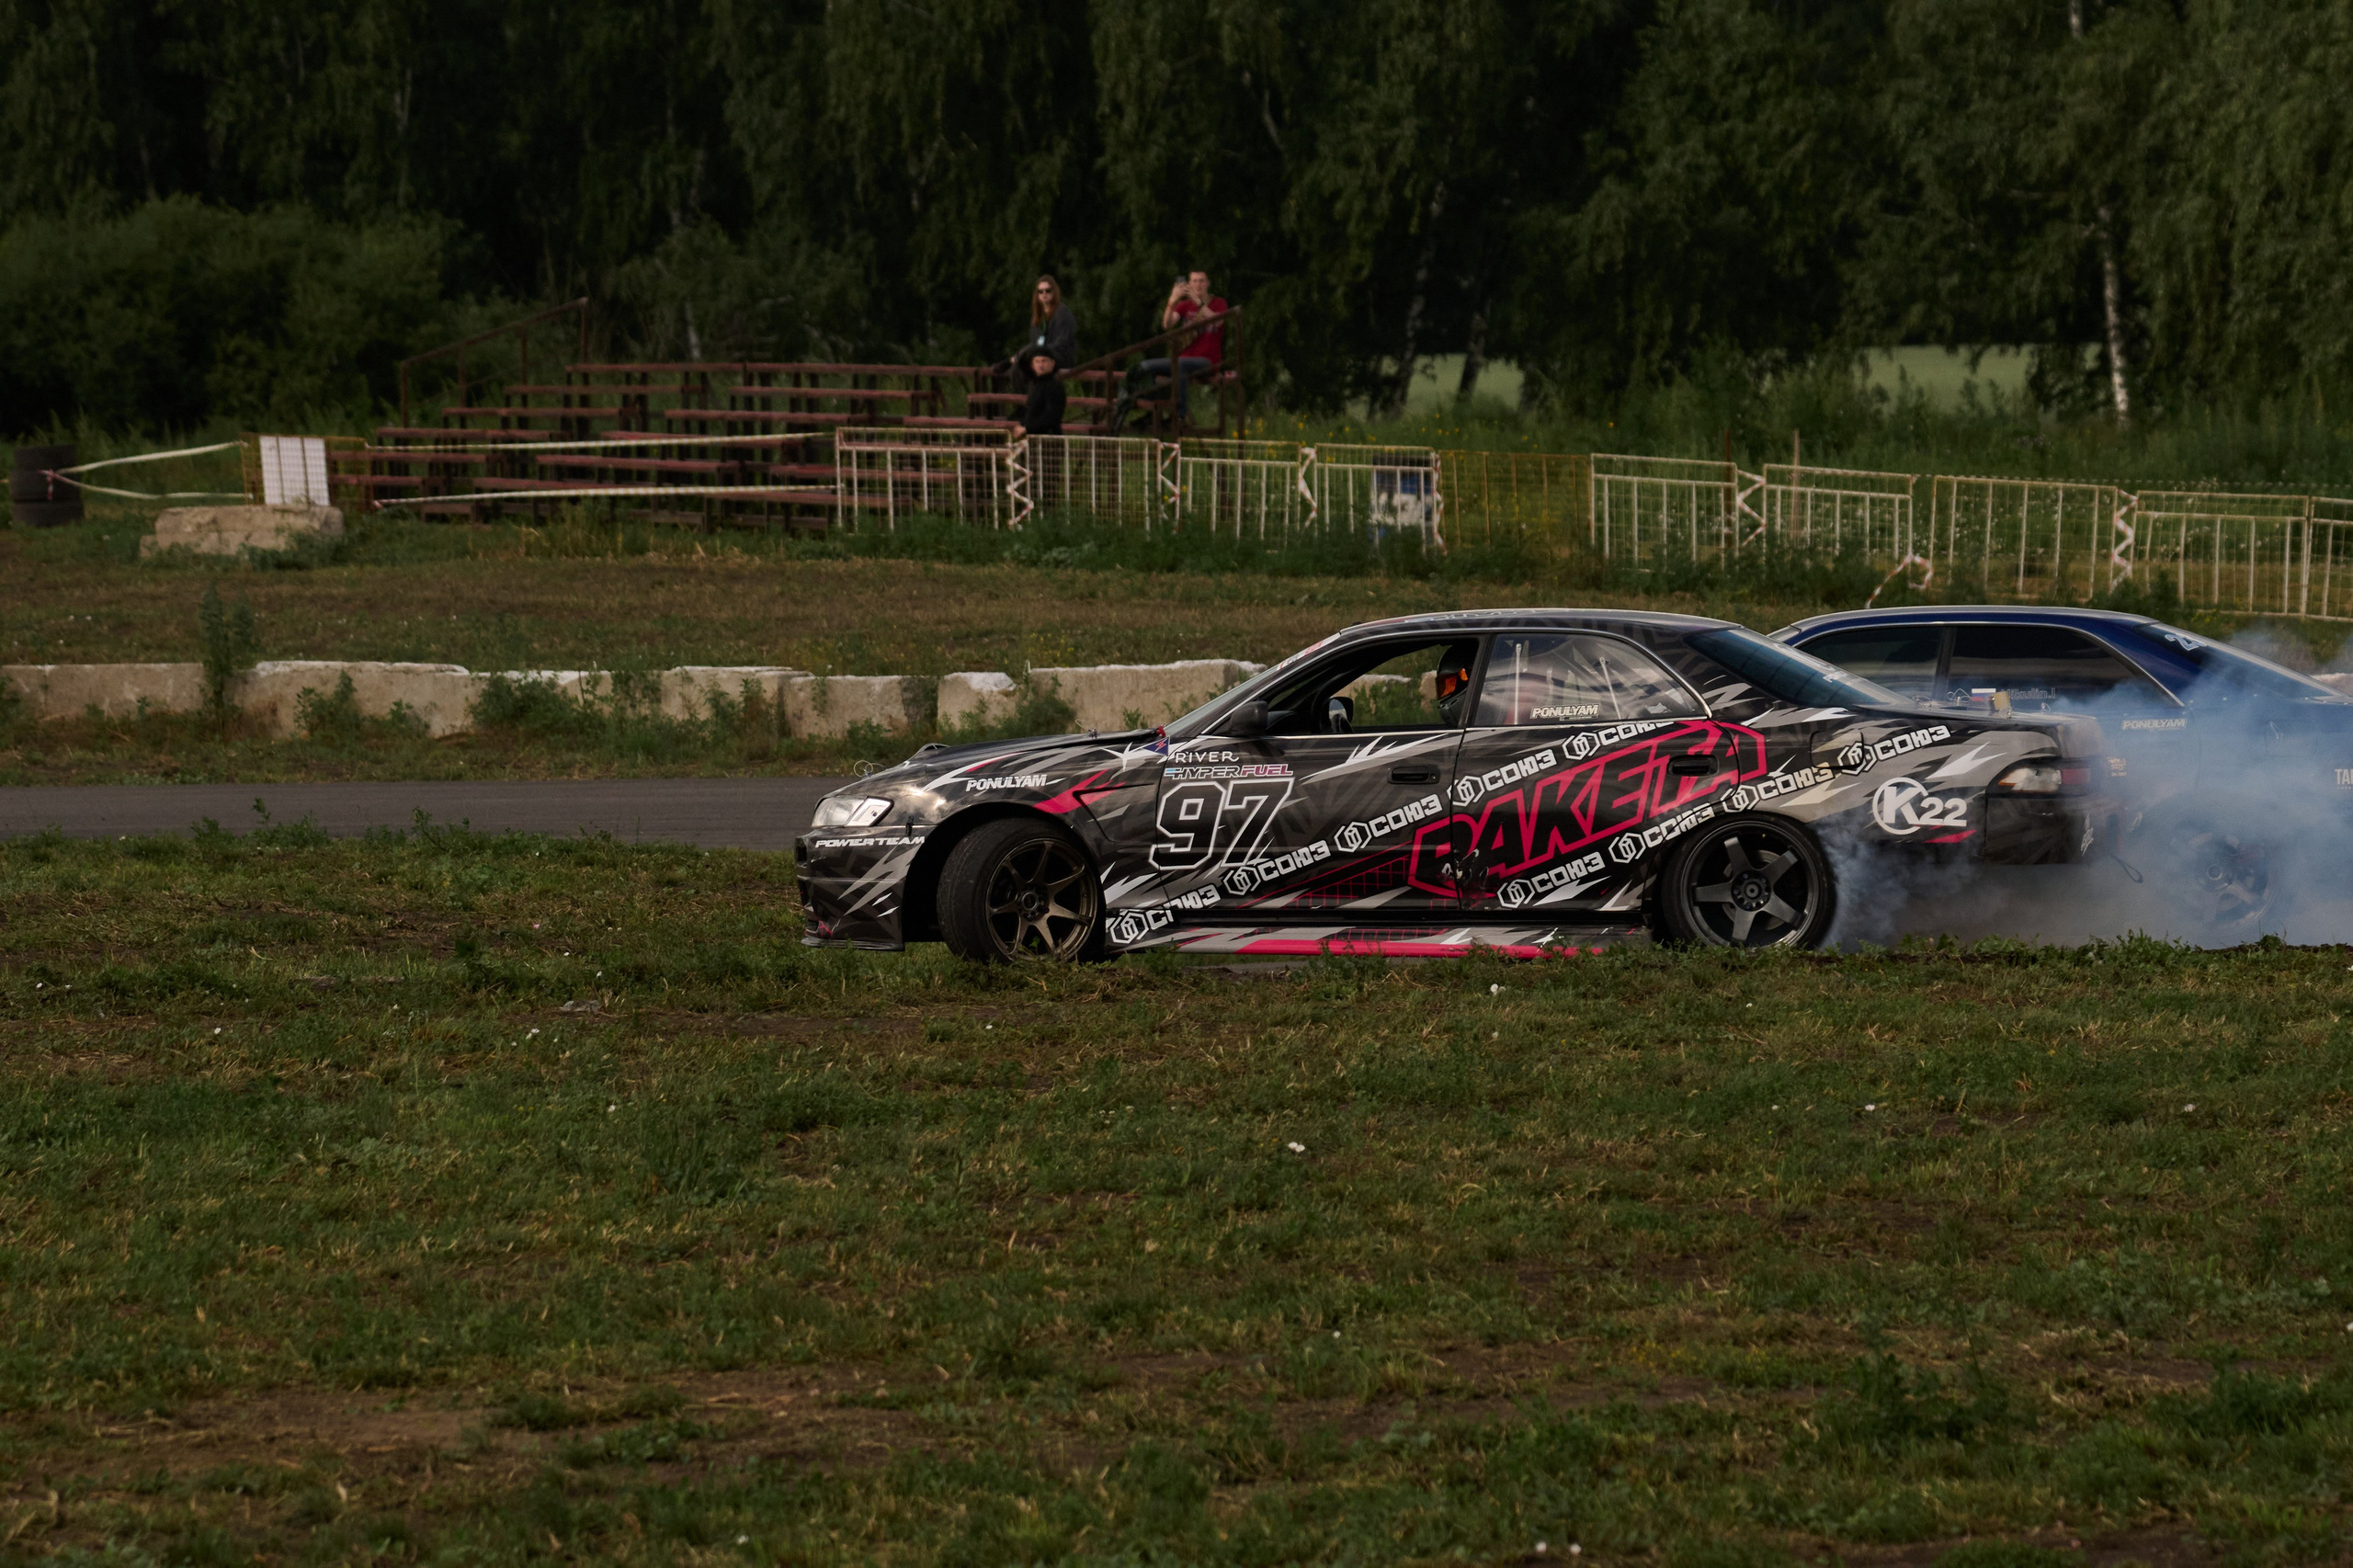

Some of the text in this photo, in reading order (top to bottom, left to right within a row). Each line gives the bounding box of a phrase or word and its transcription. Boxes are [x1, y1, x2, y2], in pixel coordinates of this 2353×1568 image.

[1531, 704, 1599, 718] PONULYAM
[2121, 719, 2187, 731] PONULYAM
[1175, 751, 1240, 764] RIVER
[965, 774, 1048, 791] PONULYAM
[1257, 840, 1332, 882] СОЮЗ
[1369, 793, 1443, 838] СОЮЗ
[1484, 749, 1557, 790] СОЮЗ
[1534, 725, 1951, 893] СОЮЗ СОЮЗ СОЮЗ СОЮЗ
[1878, 781, 1968, 829] K22
[1149, 778, 1296, 871] 97
